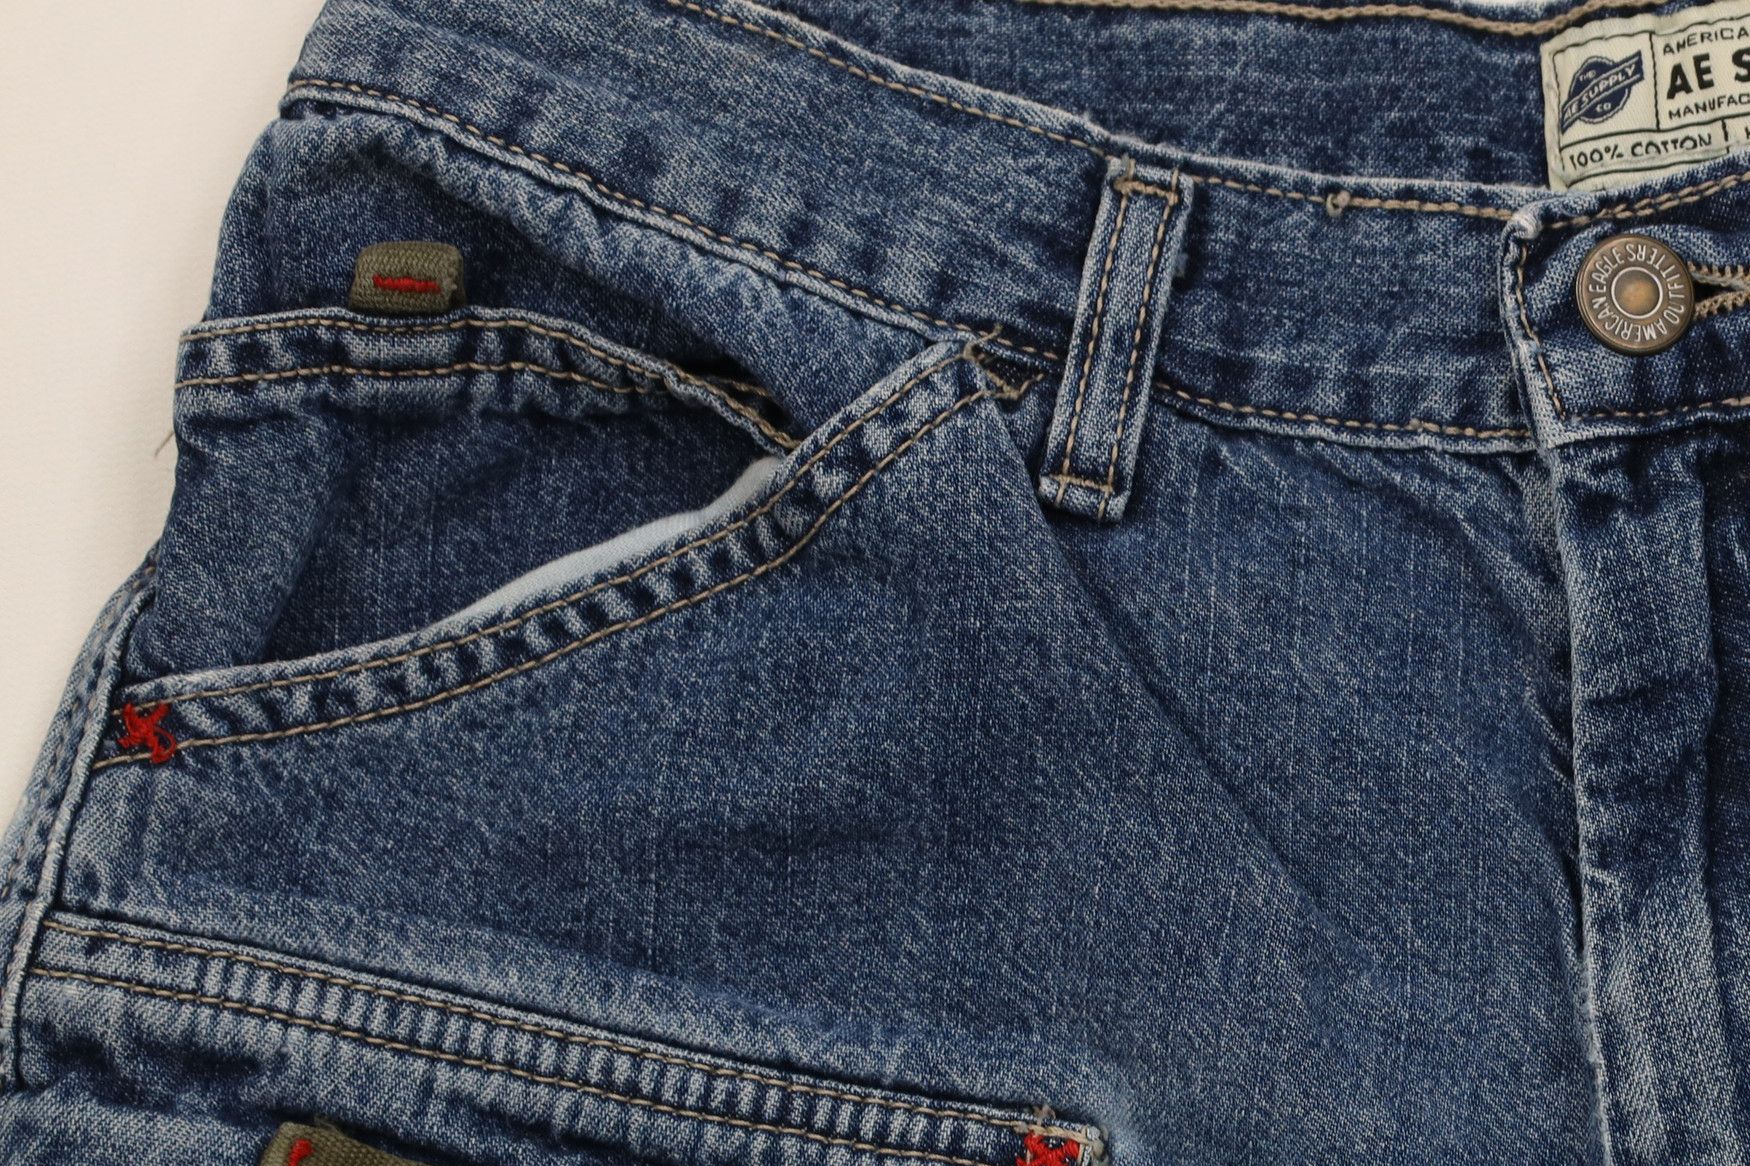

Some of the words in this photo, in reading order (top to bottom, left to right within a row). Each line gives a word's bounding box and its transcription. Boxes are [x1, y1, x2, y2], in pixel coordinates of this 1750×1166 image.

[1580, 64, 1636, 108] SUPPLY
[1666, 52, 1715, 100] AE
[1595, 102, 1612, 113] CO
[1569, 144, 1623, 170] 100%
[1631, 133, 1712, 157] COTTON
[1588, 247, 1625, 293] EAGLE
[1625, 243, 1686, 325] OUTFITTERS
[1592, 295, 1668, 342] AMERICAN
